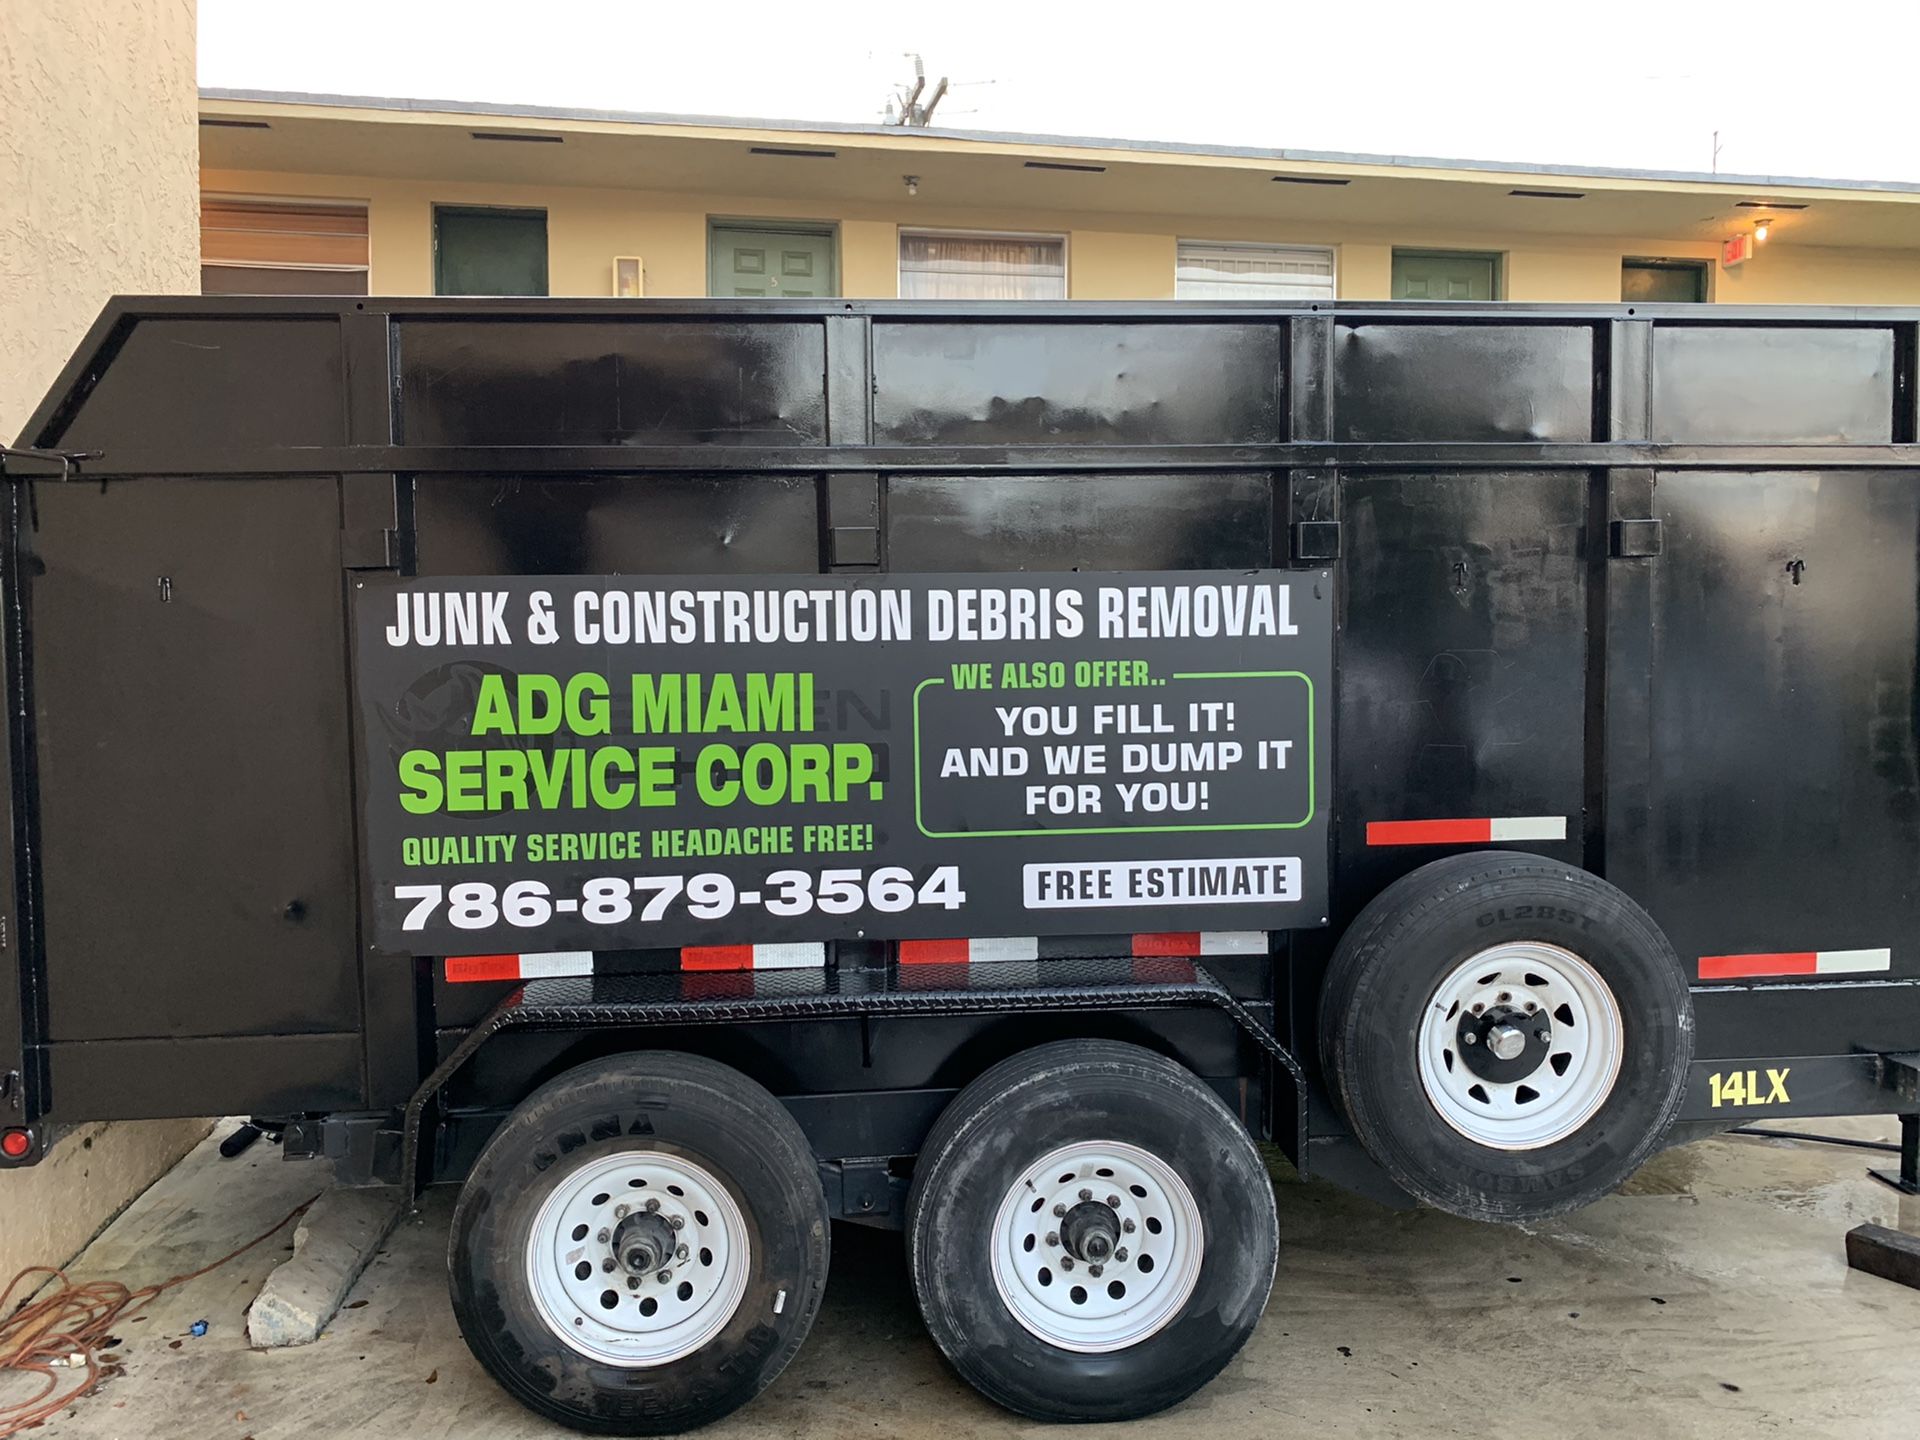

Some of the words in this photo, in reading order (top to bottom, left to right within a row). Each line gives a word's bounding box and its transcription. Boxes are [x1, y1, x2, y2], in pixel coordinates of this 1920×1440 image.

[386, 592, 513, 647] JUNK
[528, 591, 560, 645] &
[574, 589, 912, 644] CONSTRUCTION
[928, 588, 1084, 642] DEBRIS
[1099, 585, 1299, 639] REMOVAL
[953, 664, 992, 690] WE
[1002, 663, 1067, 689] ALSO
[1076, 662, 1166, 687] OFFER..
[471, 672, 611, 737] ADG
[632, 672, 815, 734] MIAMI
[995, 706, 1078, 737] YOU
[1093, 704, 1175, 734] FILL
[1189, 702, 1235, 732] IT!
[399, 746, 677, 815] SERVICE
[696, 742, 884, 807] CORP.
[940, 747, 1029, 778] AND
[1043, 745, 1107, 775] WE
[1122, 742, 1243, 773] DUMP
[1258, 740, 1293, 770] IT
[1026, 784, 1102, 815] FOR
[1115, 782, 1209, 813] YOU!
[403, 835, 517, 866] QUALITY
[527, 831, 641, 862] SERVICE
[652, 826, 793, 857] HEADACHE
[803, 824, 874, 852] FREE!
[394, 866, 967, 931] 786-879-3564
[1038, 869, 1113, 901] FREE
[1128, 864, 1288, 898] ESTIMATE
[1708, 1068, 1791, 1108] 14LX
